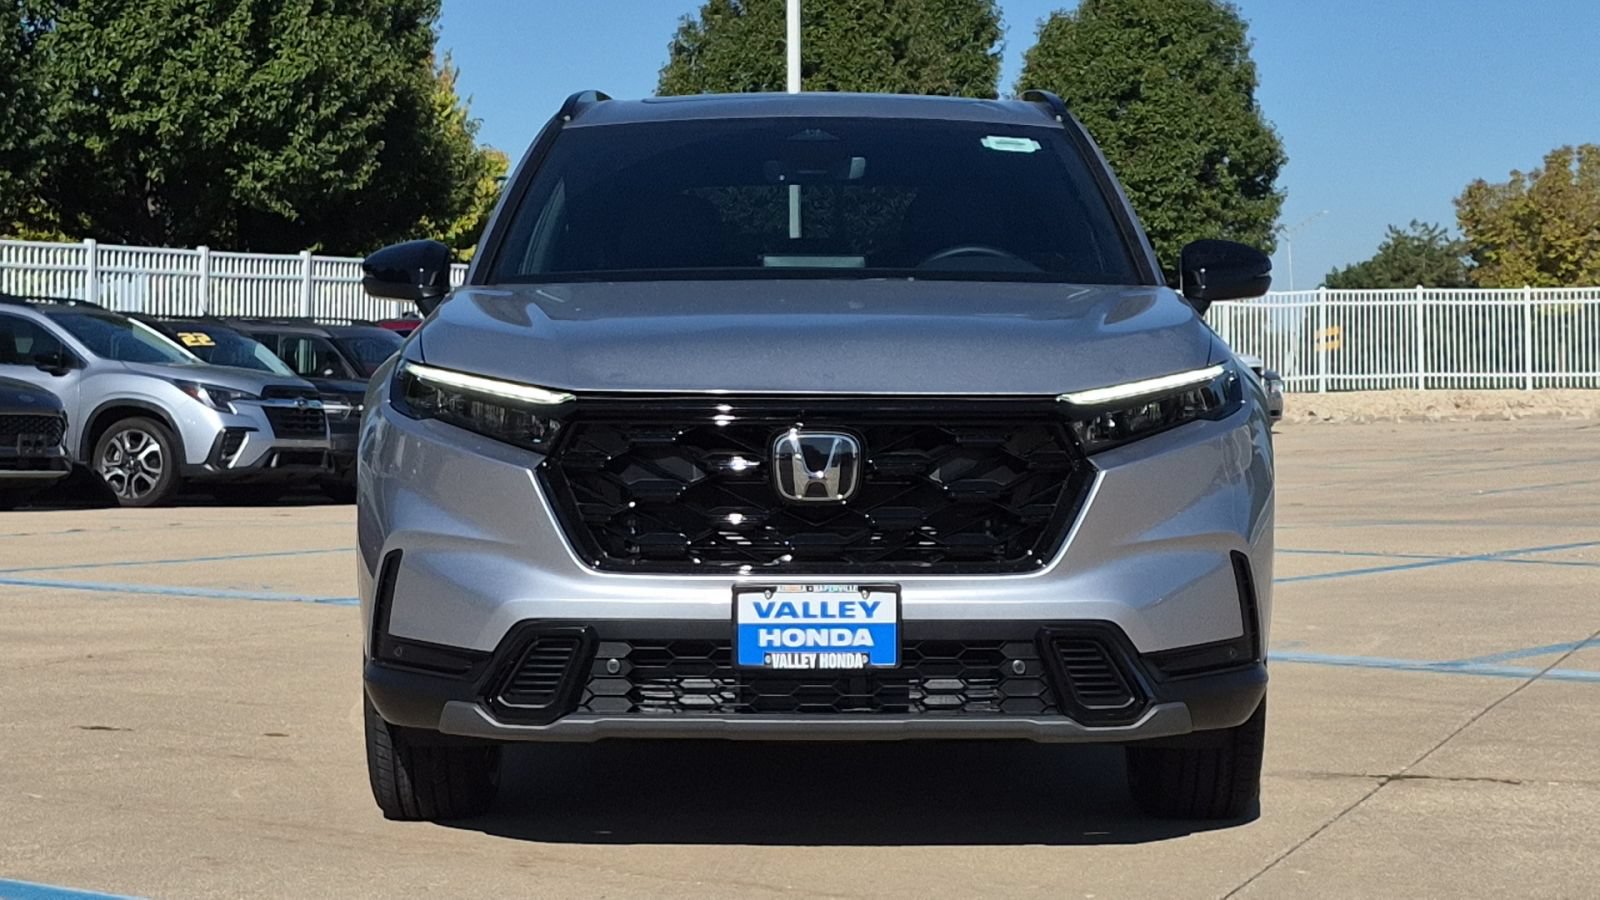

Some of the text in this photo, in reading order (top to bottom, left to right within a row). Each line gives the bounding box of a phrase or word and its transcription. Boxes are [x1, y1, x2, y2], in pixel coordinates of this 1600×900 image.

[176, 332, 216, 347] 22
[752, 601, 881, 619] VALLEY
[757, 628, 875, 647] HONDA
[771, 653, 864, 669] VALLEY HONDA
